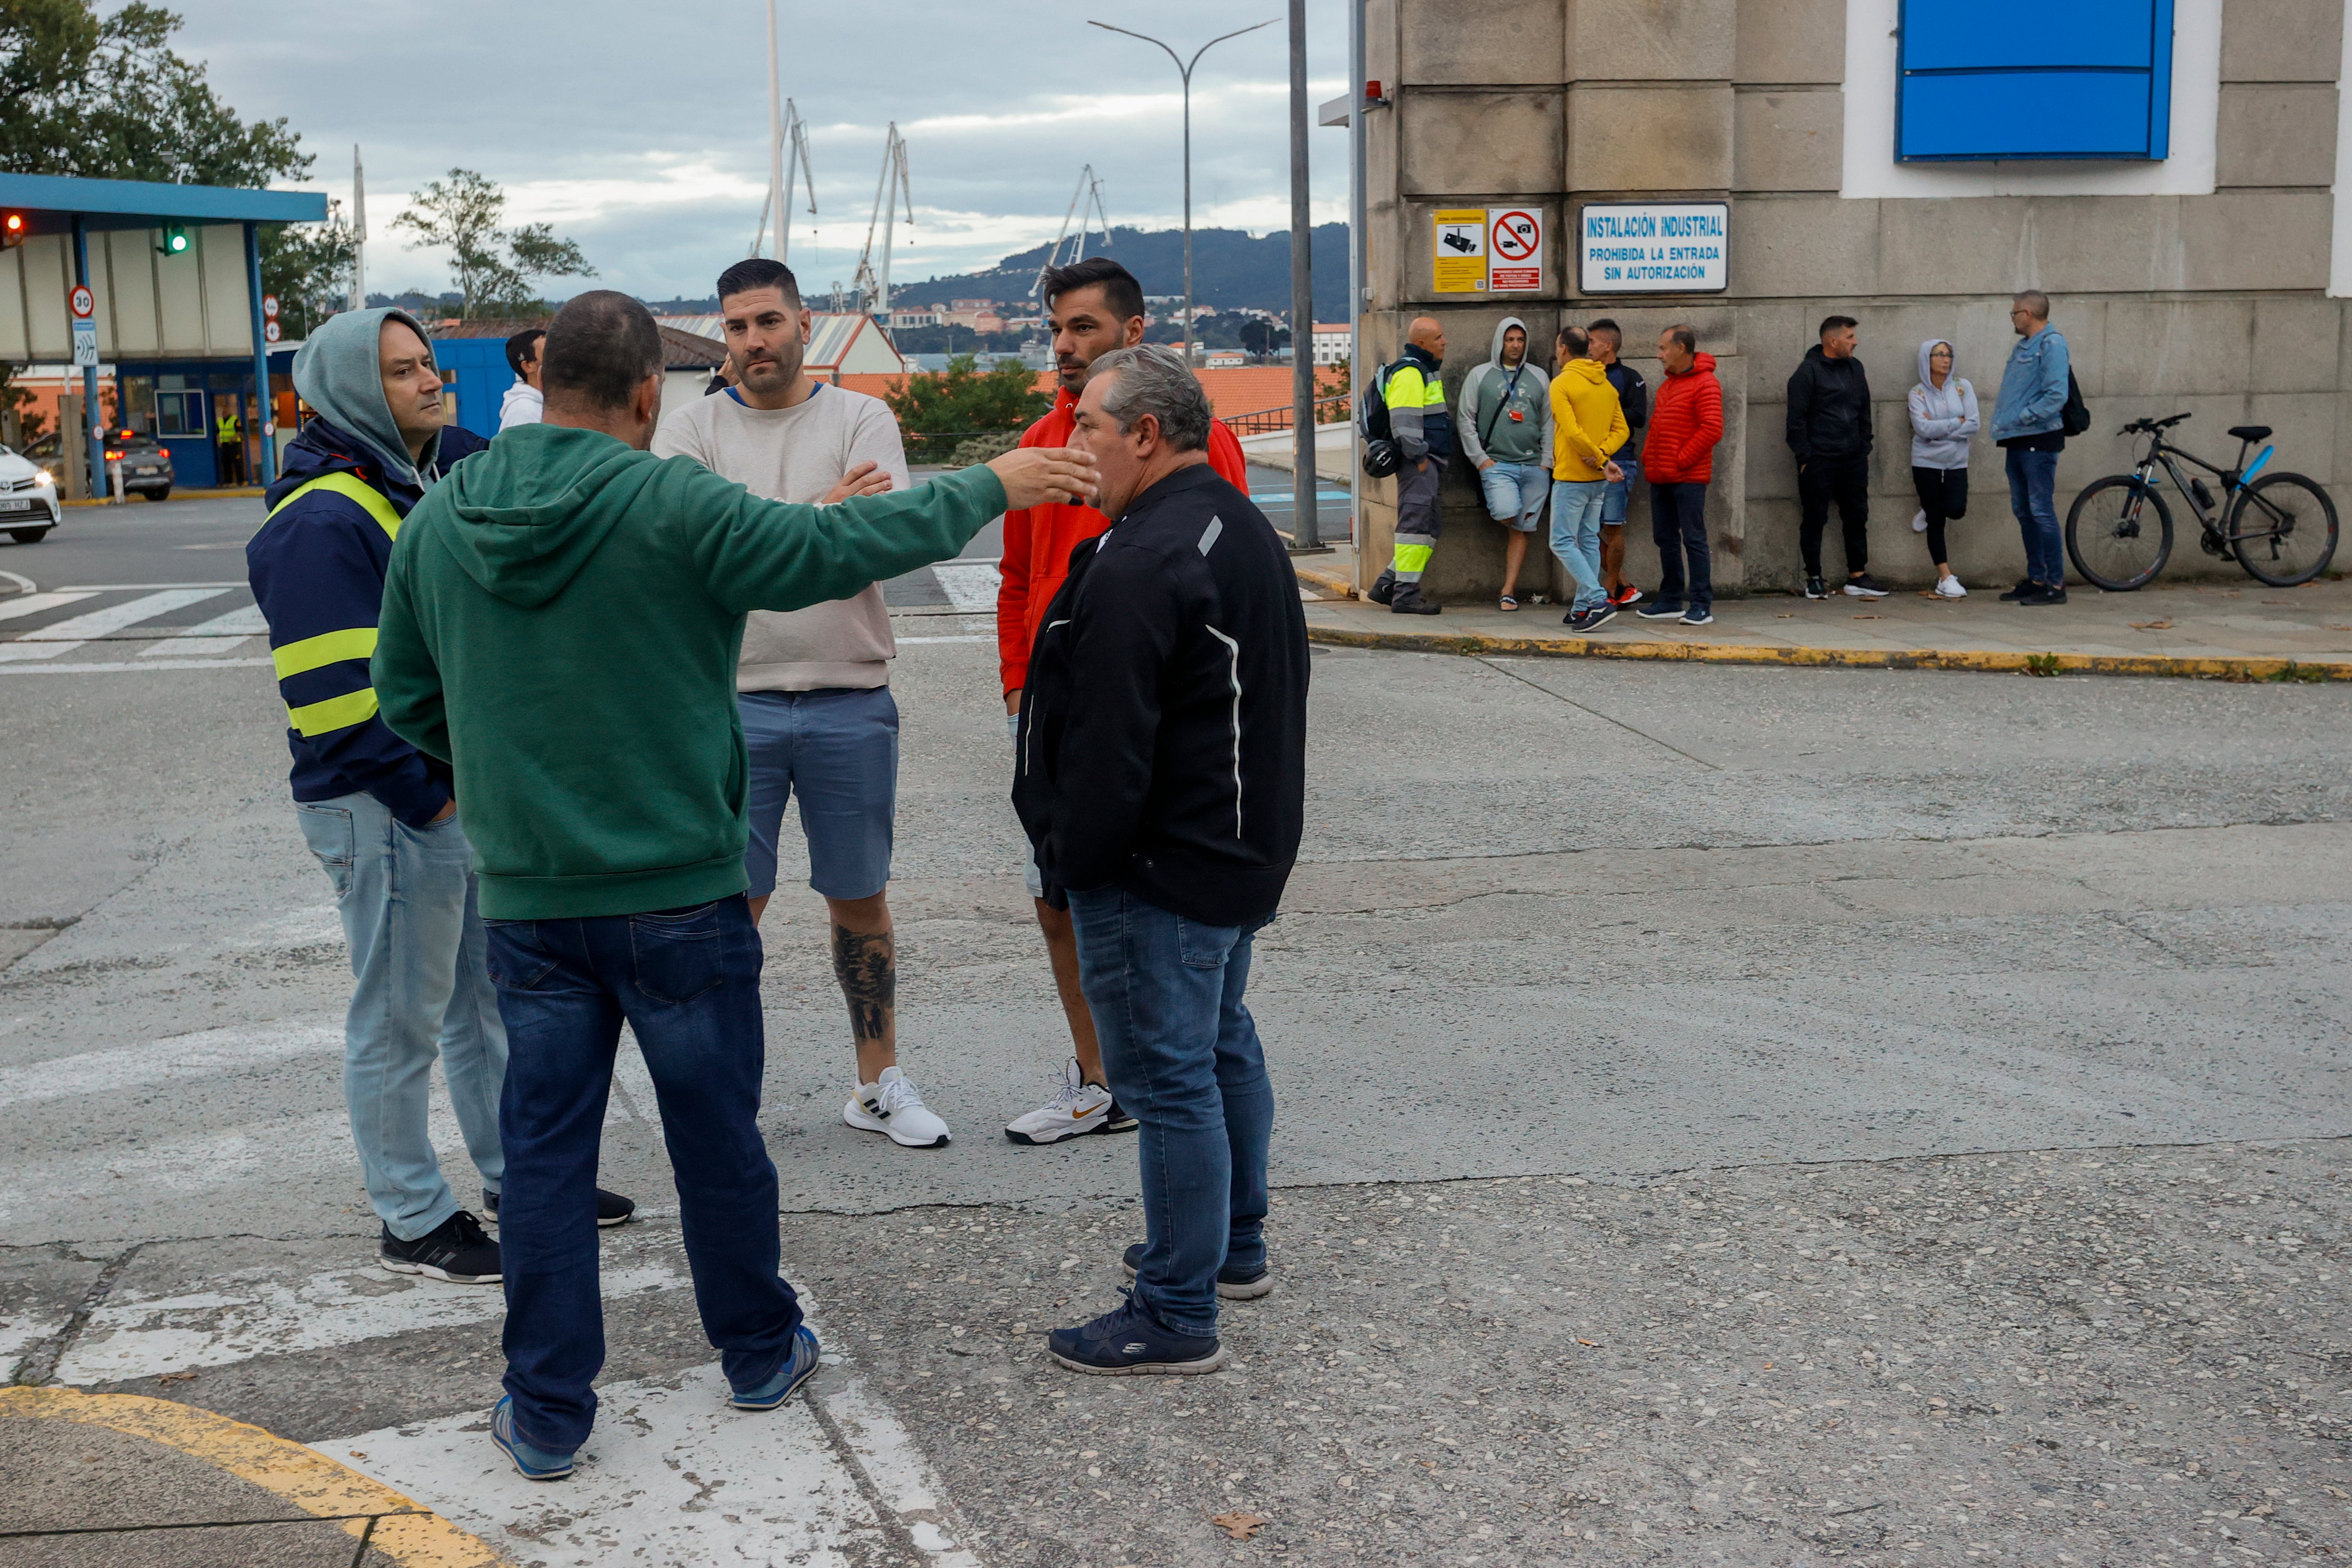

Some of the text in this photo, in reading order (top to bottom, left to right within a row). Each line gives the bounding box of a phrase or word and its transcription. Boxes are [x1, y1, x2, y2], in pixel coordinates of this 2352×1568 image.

[1587, 212, 1723, 238] INSTALACIÓN INDUSTRIAL
[1589, 247, 1719, 261] PROHIBIDA LA ENTRADA
[1605, 263, 1705, 280] SIN AUTORIZACIÓN
[76, 297, 89, 307] 30
